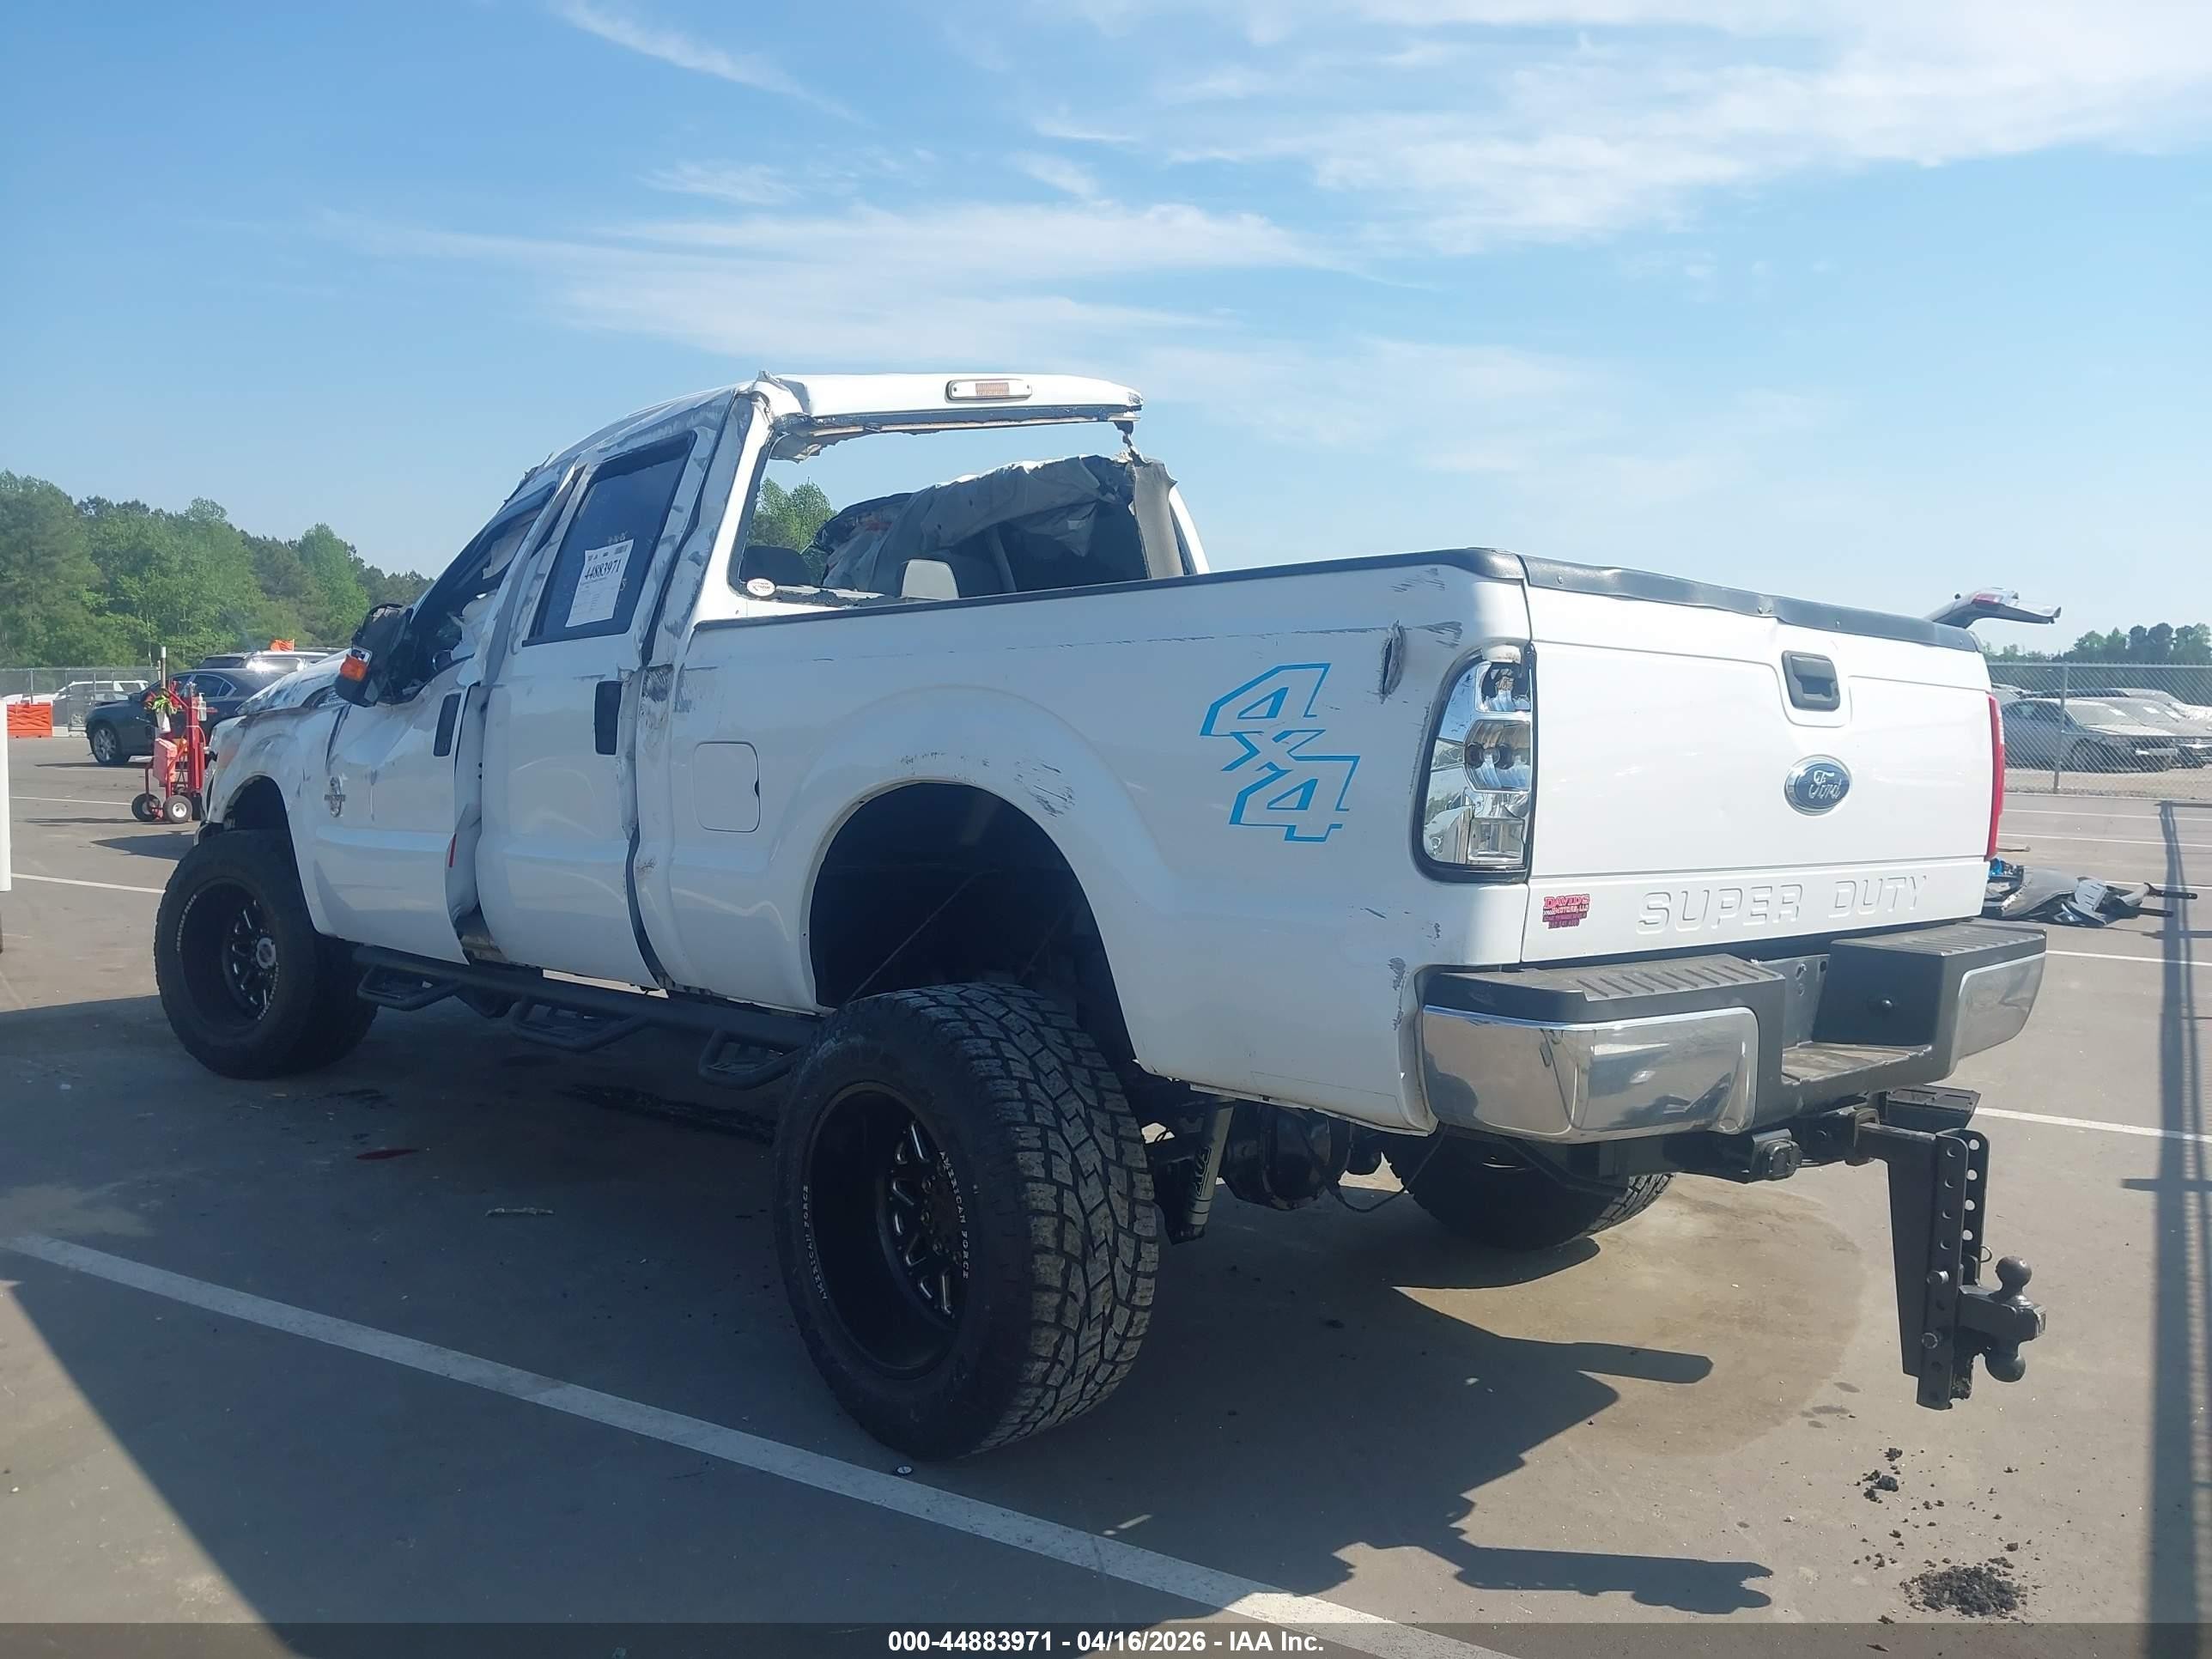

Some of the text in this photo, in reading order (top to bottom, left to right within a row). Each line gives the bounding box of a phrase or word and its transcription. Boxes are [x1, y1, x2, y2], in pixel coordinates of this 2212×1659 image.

[585, 558, 622, 580] 44883971
[1808, 769, 1842, 799] Ford
[1637, 874, 1929, 935] SUPER DUTY
[960, 1229, 969, 1279] FORCE
